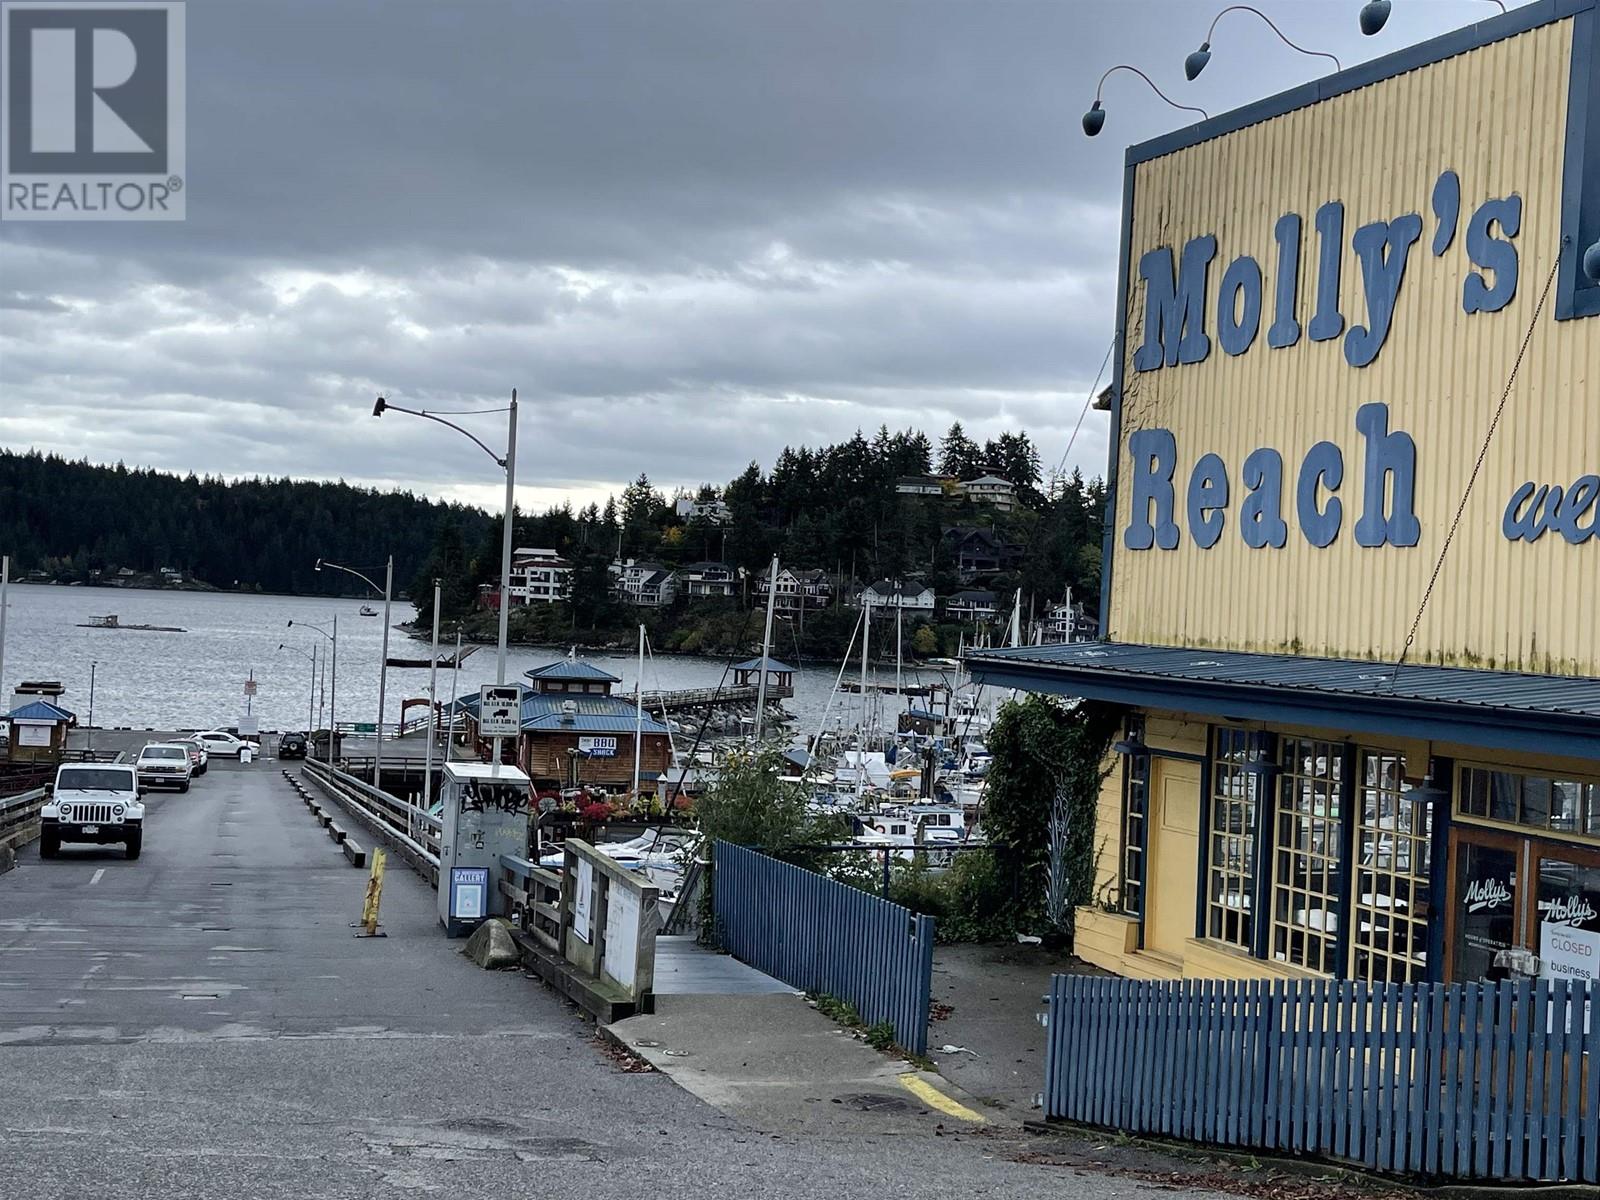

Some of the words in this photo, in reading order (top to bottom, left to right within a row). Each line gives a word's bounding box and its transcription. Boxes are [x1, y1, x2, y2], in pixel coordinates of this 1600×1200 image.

[1133, 169, 1522, 373] Molly's
[1123, 402, 1421, 551] Reach
[1502, 474, 1600, 545] we
[593, 738, 615, 748] BBQ
[455, 874, 485, 883] GALLERY
[1463, 877, 1512, 909] Molly's
[1544, 894, 1598, 927] Molly's
[1551, 938, 1592, 957] CLOSED
[1551, 960, 1591, 979] business
